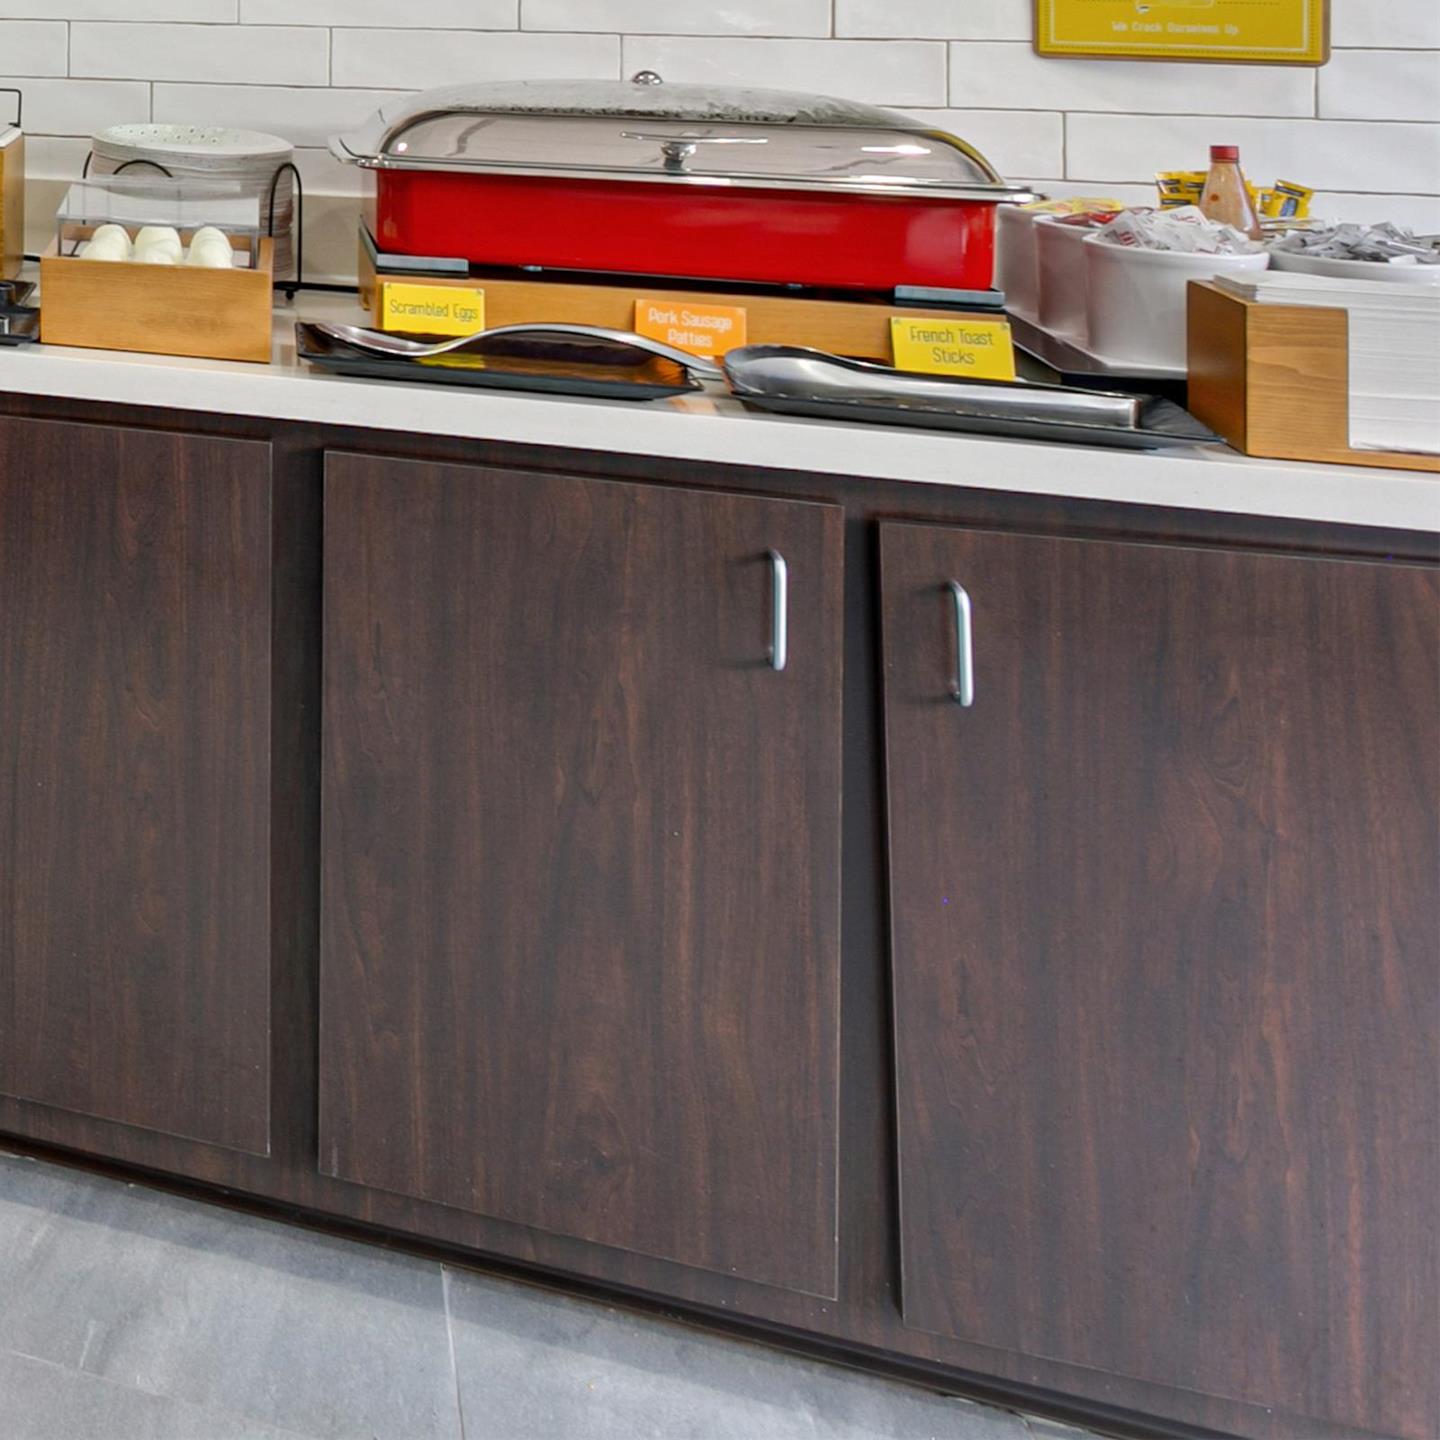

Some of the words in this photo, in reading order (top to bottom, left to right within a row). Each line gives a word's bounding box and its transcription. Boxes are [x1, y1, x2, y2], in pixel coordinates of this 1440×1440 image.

[390, 299, 450, 318] Scrambled
[452, 303, 479, 323] Eggs
[648, 307, 678, 325] Pork
[680, 310, 733, 334] Sausage
[667, 328, 713, 348] Patties
[910, 326, 954, 343] French
[958, 328, 994, 346] Toast
[932, 346, 976, 365] Sticks
